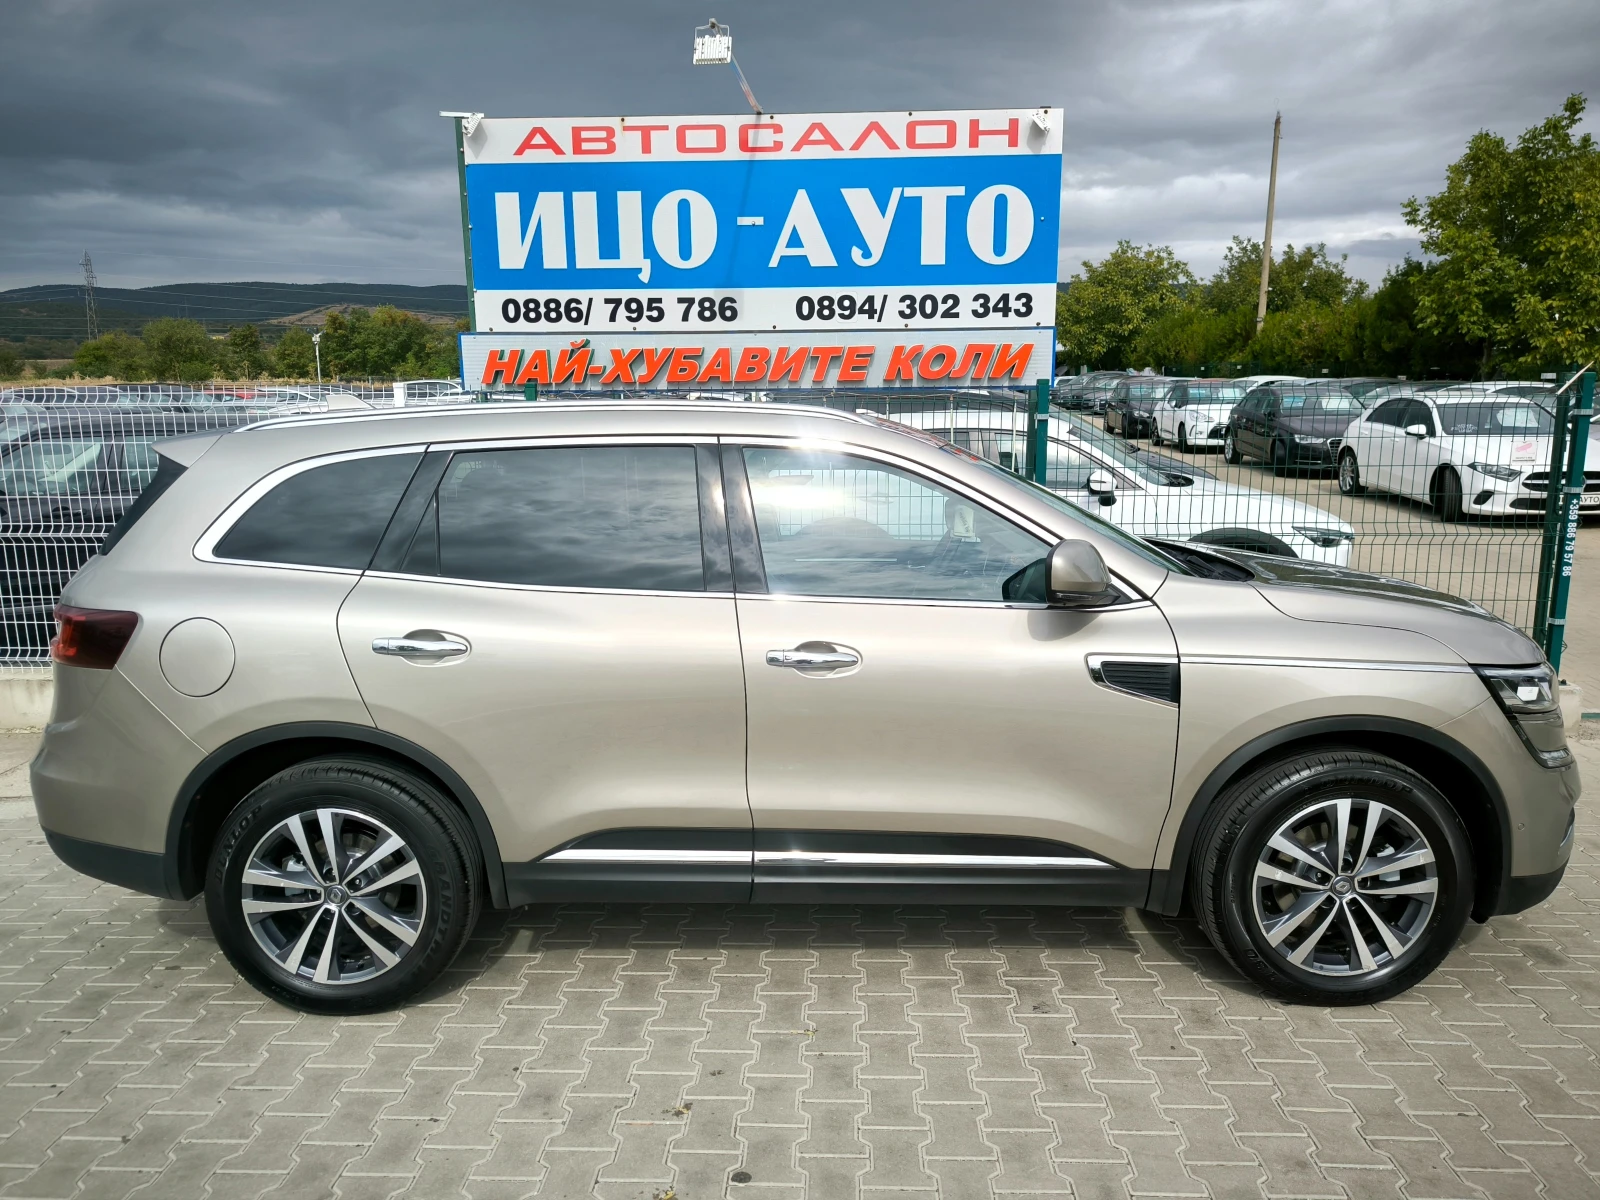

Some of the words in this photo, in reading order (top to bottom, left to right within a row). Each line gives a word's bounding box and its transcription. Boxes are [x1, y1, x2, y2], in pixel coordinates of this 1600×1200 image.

[513, 118, 1020, 156] АВТОСАЛОН
[501, 297, 593, 325] 0886/
[603, 297, 665, 323] 795
[676, 296, 738, 322] 786
[795, 295, 888, 322] 0894/
[897, 294, 960, 320] 302
[971, 293, 1034, 319] 343
[481, 339, 876, 385] НАЙ-ХУБАВИТЕ
[883, 343, 1036, 381] КОЛИ
[1569, 499, 1579, 519] +359
[1567, 523, 1576, 538] 886
[1566, 541, 1574, 551] 79
[1564, 553, 1573, 563] 57
[1563, 566, 1571, 576] 86
